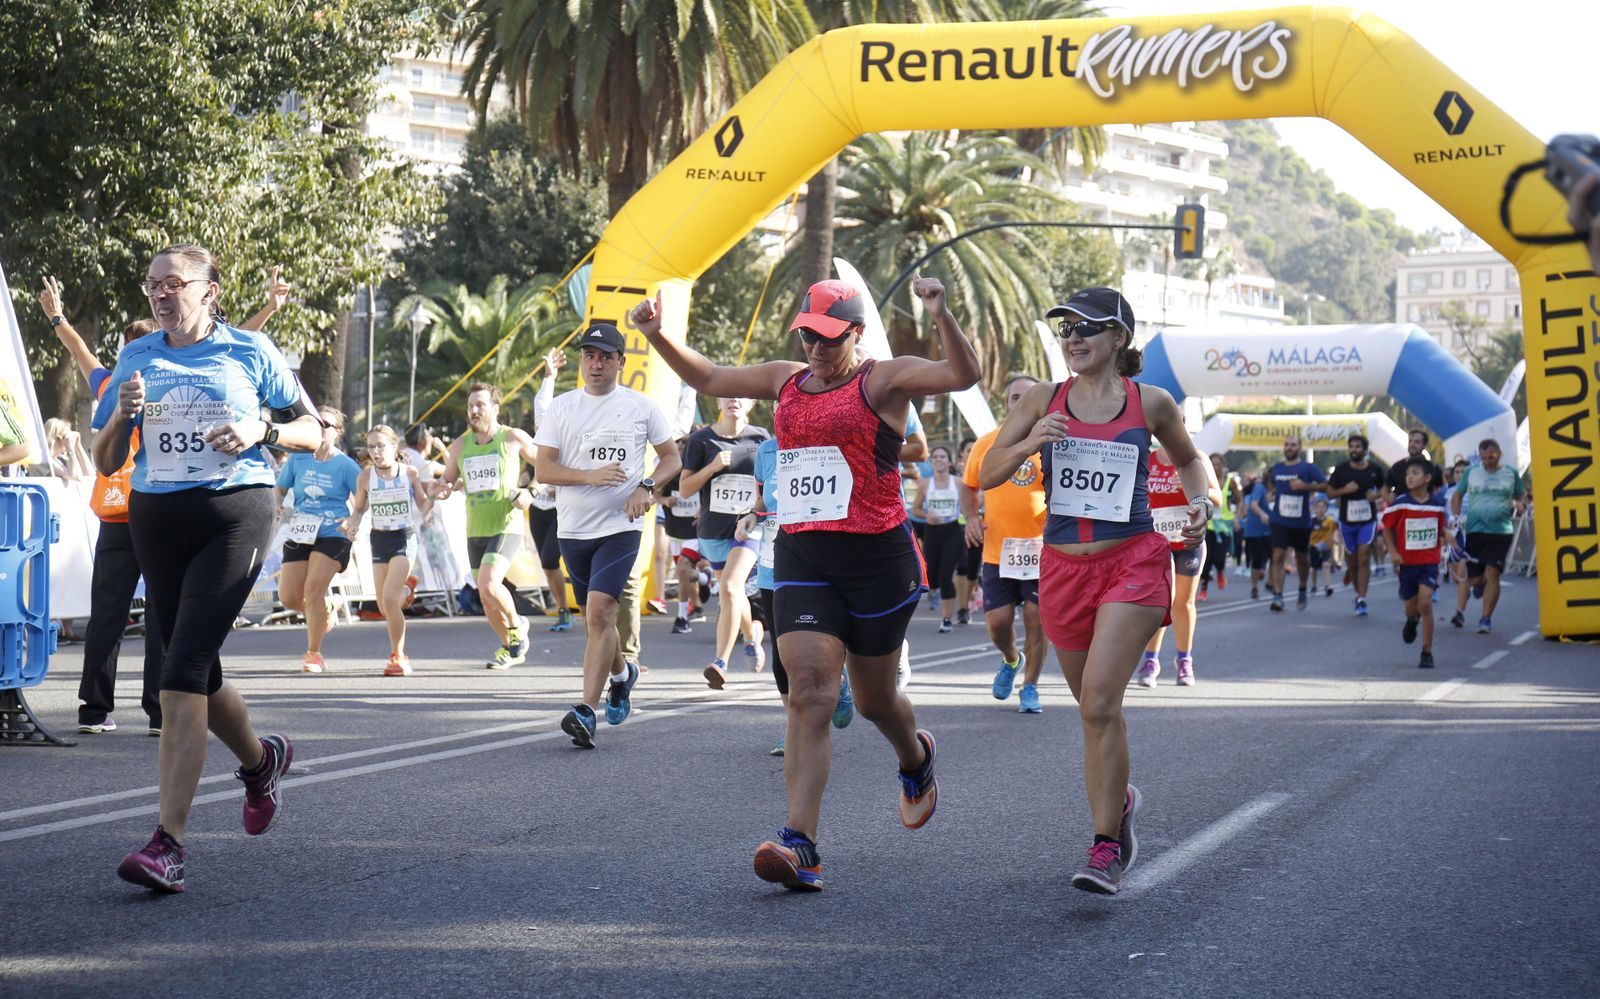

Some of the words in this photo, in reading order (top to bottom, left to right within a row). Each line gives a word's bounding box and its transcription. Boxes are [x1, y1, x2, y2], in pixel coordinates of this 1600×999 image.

[860, 35, 1079, 82] Renault
[1413, 144, 1506, 164] RENAULT
[686, 168, 766, 182] RENAULT
[1267, 344, 1362, 365] MÁLAGA
[147, 379, 176, 387] CIUDAD
[1238, 424, 1301, 438] Renault
[159, 432, 217, 453] 835
[1079, 441, 1107, 449] CARRERA
[1109, 444, 1135, 453] URBANA
[1540, 298, 1600, 584] RENAULT
[589, 447, 627, 461] 1879
[1076, 448, 1099, 456] CIUDAD
[1111, 451, 1136, 460] MÁLAGA
[467, 468, 497, 481] 13496
[1059, 467, 1121, 493] 8507
[789, 475, 837, 497] 8501
[714, 488, 752, 501] 15717
[373, 503, 408, 516] 20936
[1008, 554, 1039, 567] 3396
